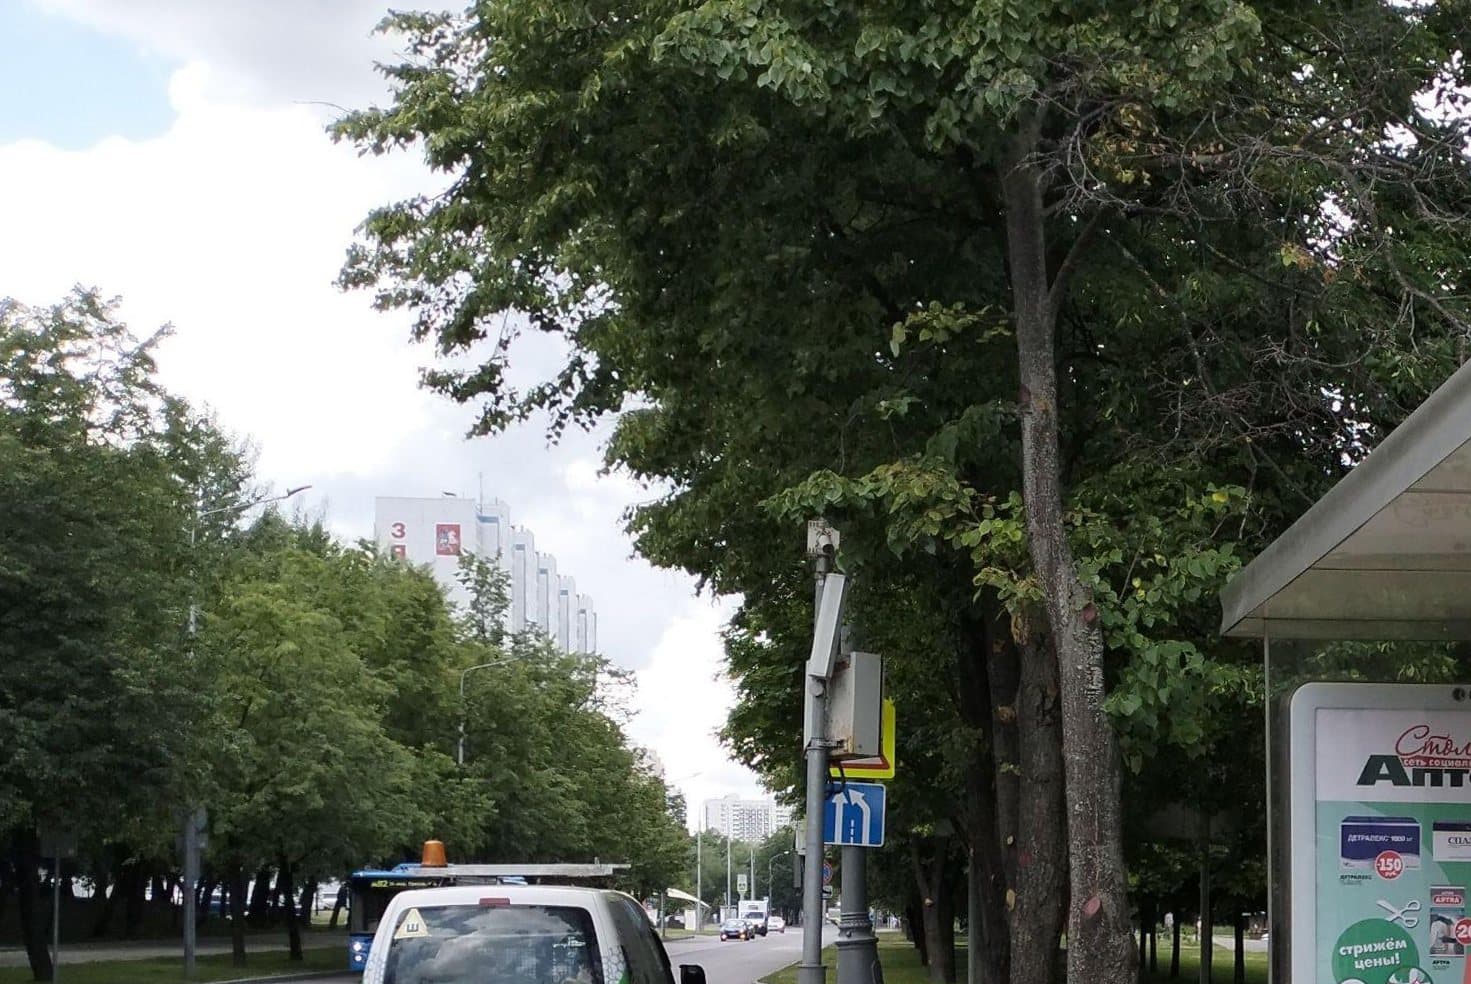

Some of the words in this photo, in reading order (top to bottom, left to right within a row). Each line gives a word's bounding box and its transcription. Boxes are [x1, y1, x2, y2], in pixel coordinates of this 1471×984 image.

[1403, 758, 1428, 768] сеть
[406, 923, 421, 934] Ш
[1339, 936, 1407, 958] стрижём
[1354, 952, 1400, 970] цены!
